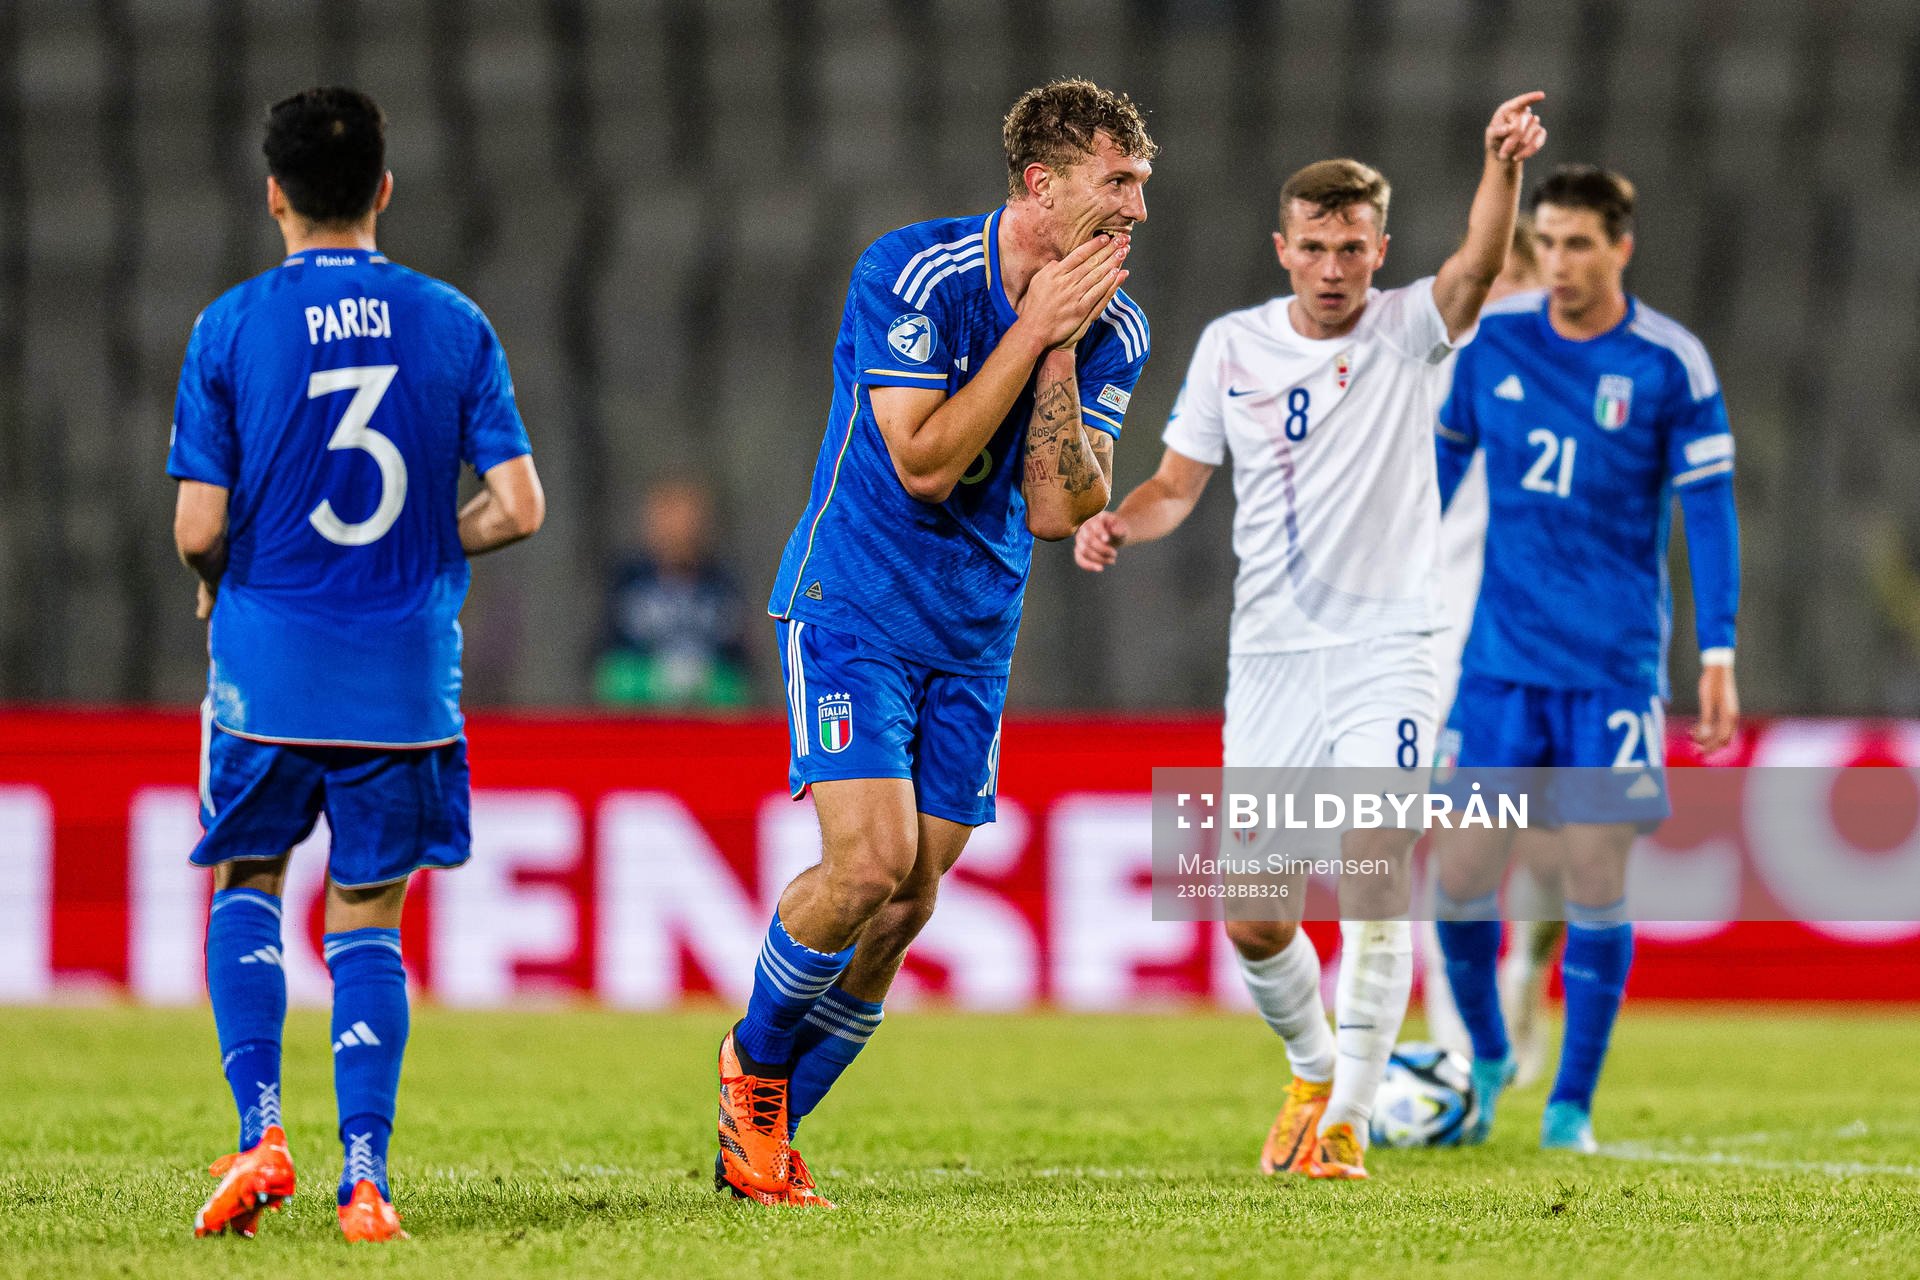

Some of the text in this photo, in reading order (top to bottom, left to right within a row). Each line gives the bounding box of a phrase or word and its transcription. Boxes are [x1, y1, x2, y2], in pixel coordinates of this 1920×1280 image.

[305, 297, 391, 345] PARISI
[1285, 388, 1310, 441] 8
[307, 365, 408, 546] 3
[1521, 428, 1577, 498] 21
[821, 705, 848, 718] ITALIA
[1397, 717, 1418, 772] 8
[1607, 709, 1660, 773] 21
